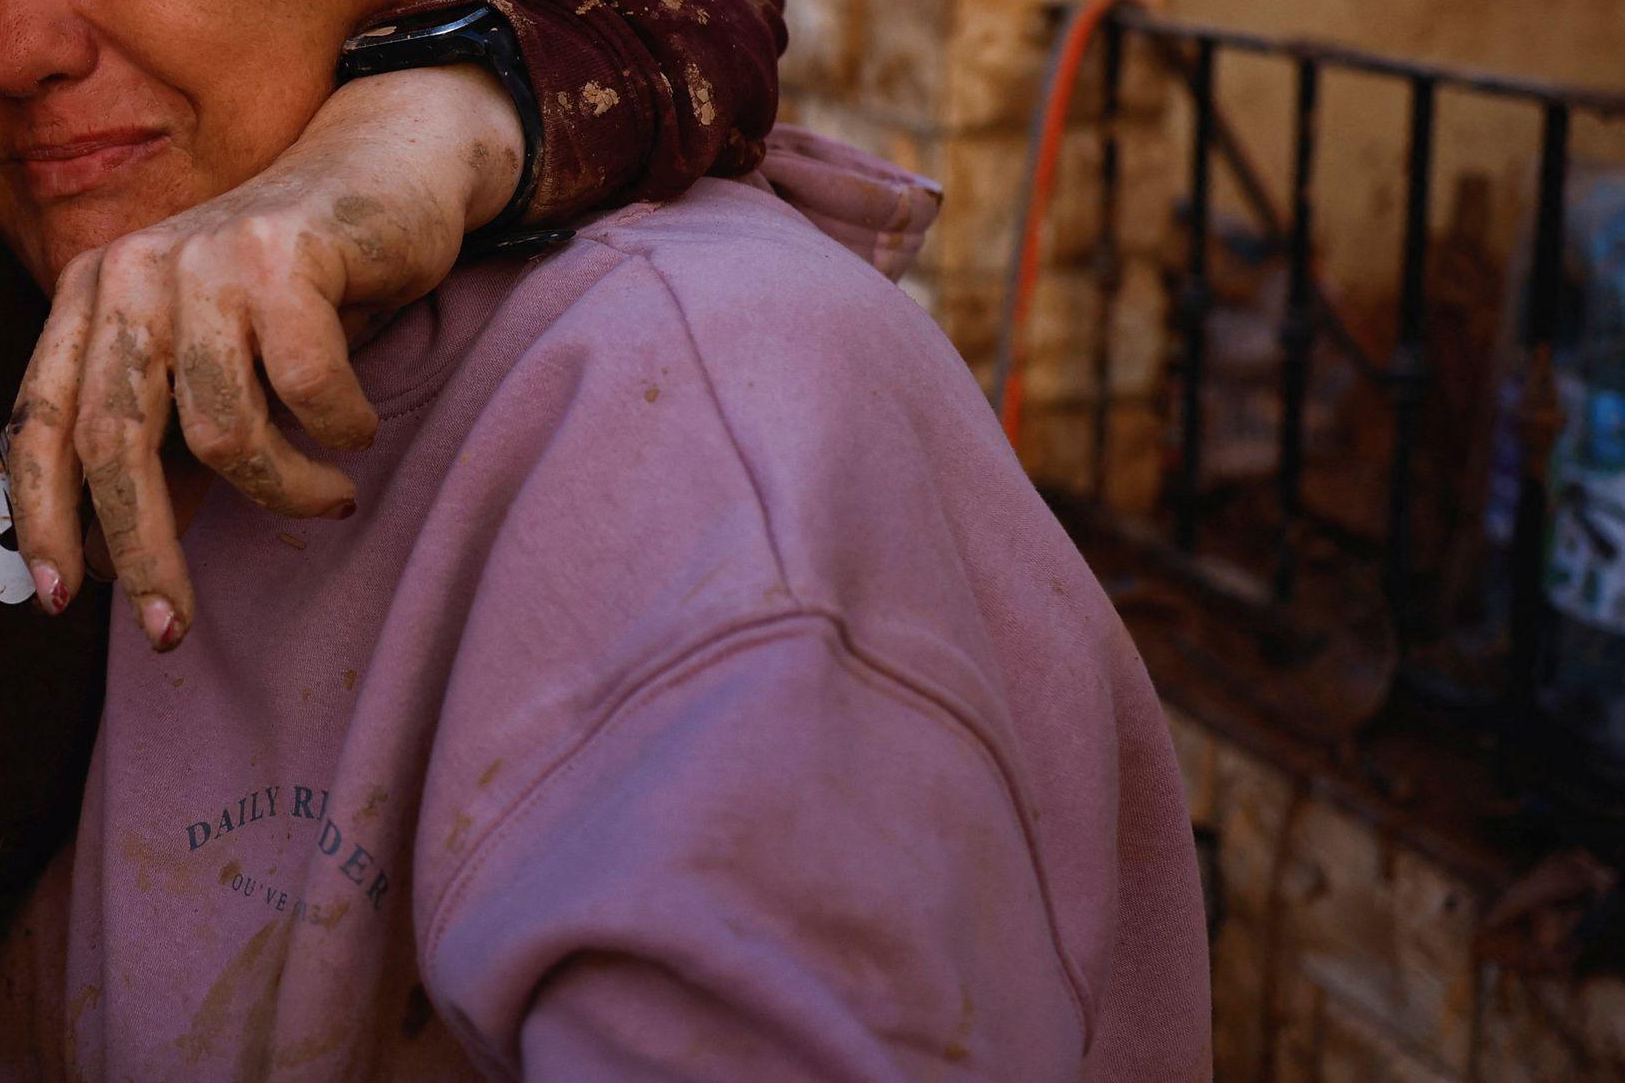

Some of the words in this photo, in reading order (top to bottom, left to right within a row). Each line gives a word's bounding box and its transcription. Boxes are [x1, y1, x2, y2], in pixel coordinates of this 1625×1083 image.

[185, 785, 281, 853] DAILY
[290, 785, 391, 912] RIDER
[229, 871, 289, 913] OU'VE
